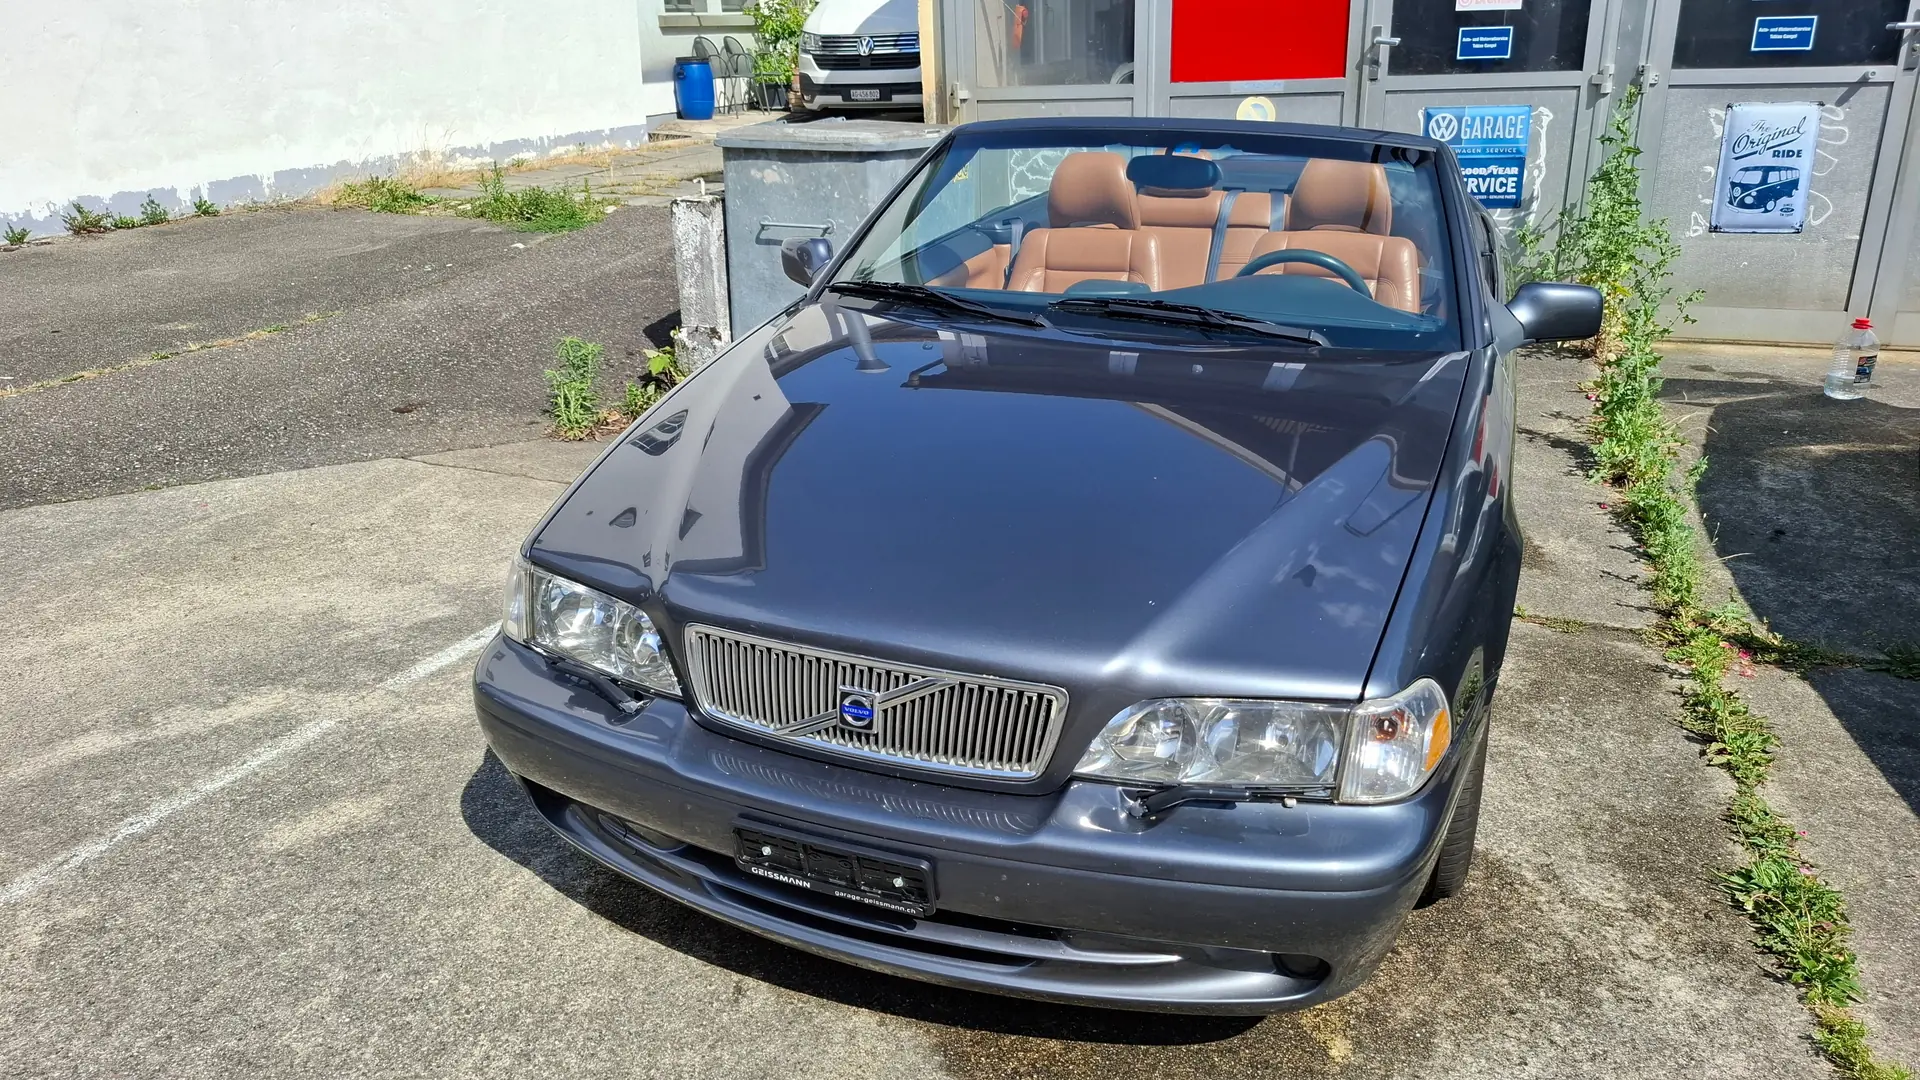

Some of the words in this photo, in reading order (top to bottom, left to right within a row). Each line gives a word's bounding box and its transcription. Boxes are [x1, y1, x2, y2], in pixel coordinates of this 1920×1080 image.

[1460, 115, 1526, 139] GARAGE
[1732, 116, 1806, 155] Original
[1772, 149, 1803, 158] RIDE
[1464, 177, 1517, 193] RVICE
[844, 706, 869, 715] VOLVO
[751, 867, 811, 888] GEISSMANN
[834, 889, 917, 915] garage-geissmann.ch
